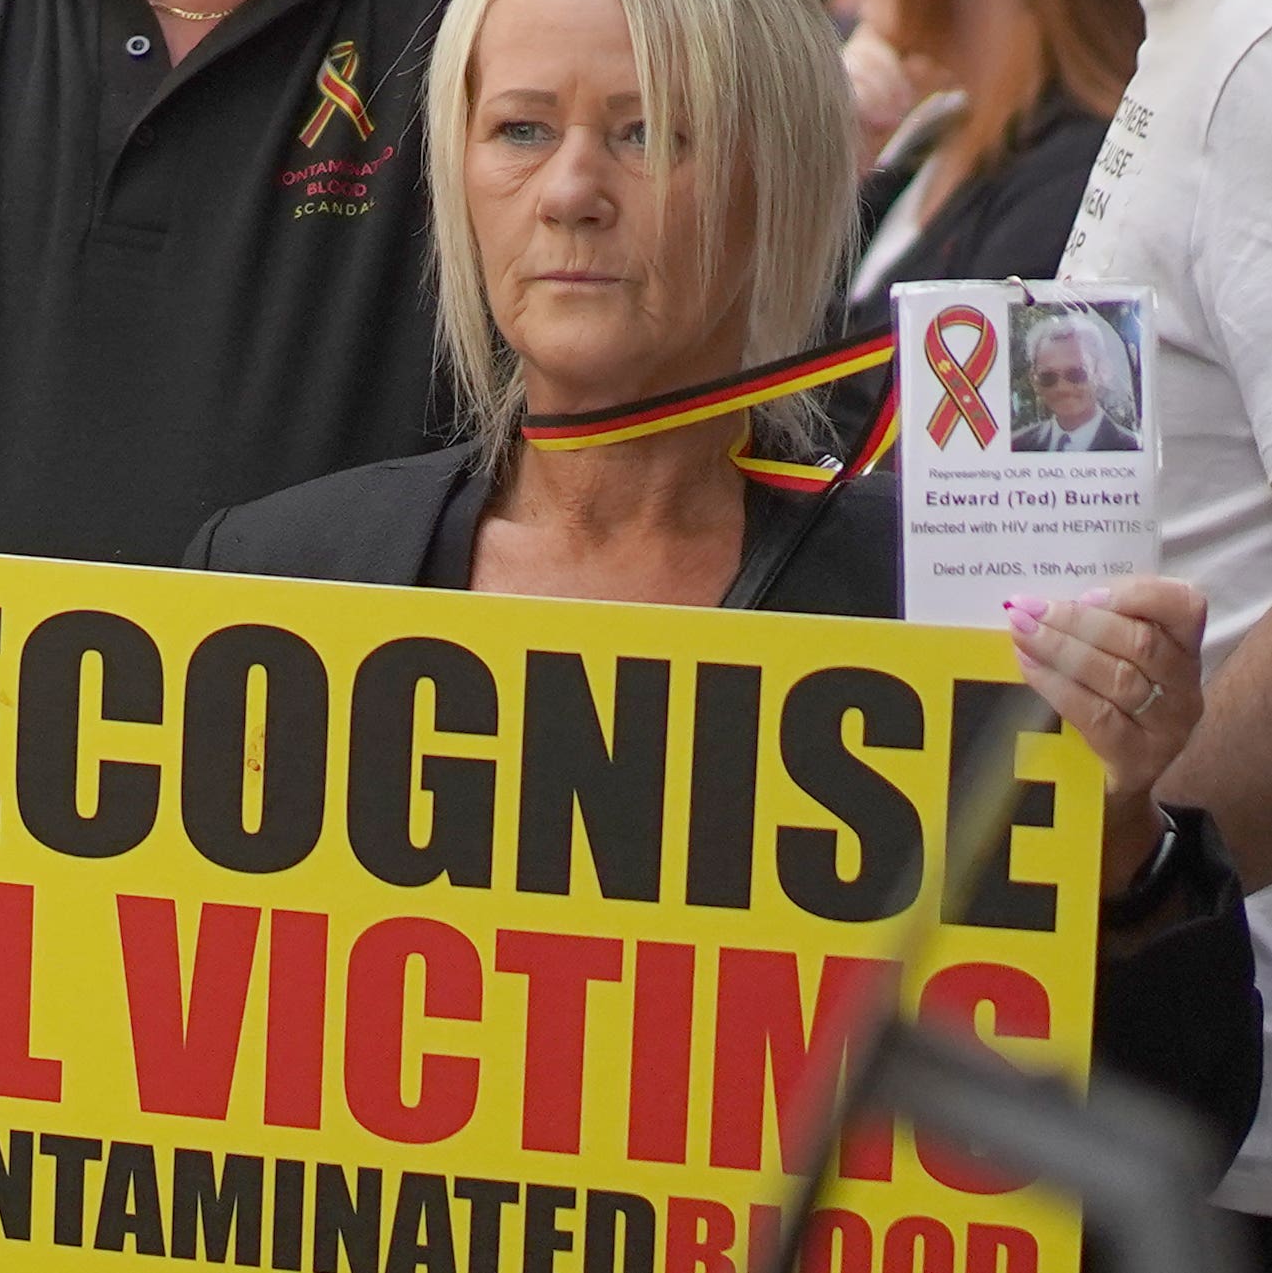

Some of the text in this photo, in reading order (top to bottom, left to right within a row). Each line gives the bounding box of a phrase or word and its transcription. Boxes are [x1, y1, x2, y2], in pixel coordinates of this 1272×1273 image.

[293, 197, 377, 220] SCANDAL
[928, 467, 1001, 481] Representing
[1003, 468, 1031, 478] OUR
[925, 490, 1141, 509] Edward (Ted) Burkert
[910, 520, 966, 534] Infected
[969, 520, 998, 534] with
[1002, 520, 1029, 533] HIV
[1032, 520, 1058, 533] and
[1062, 519, 1141, 533] HEPATITIS
[933, 562, 965, 576] Died
[968, 562, 983, 576] of
[1031, 562, 1061, 576] 15th
[1064, 562, 1097, 578] April
